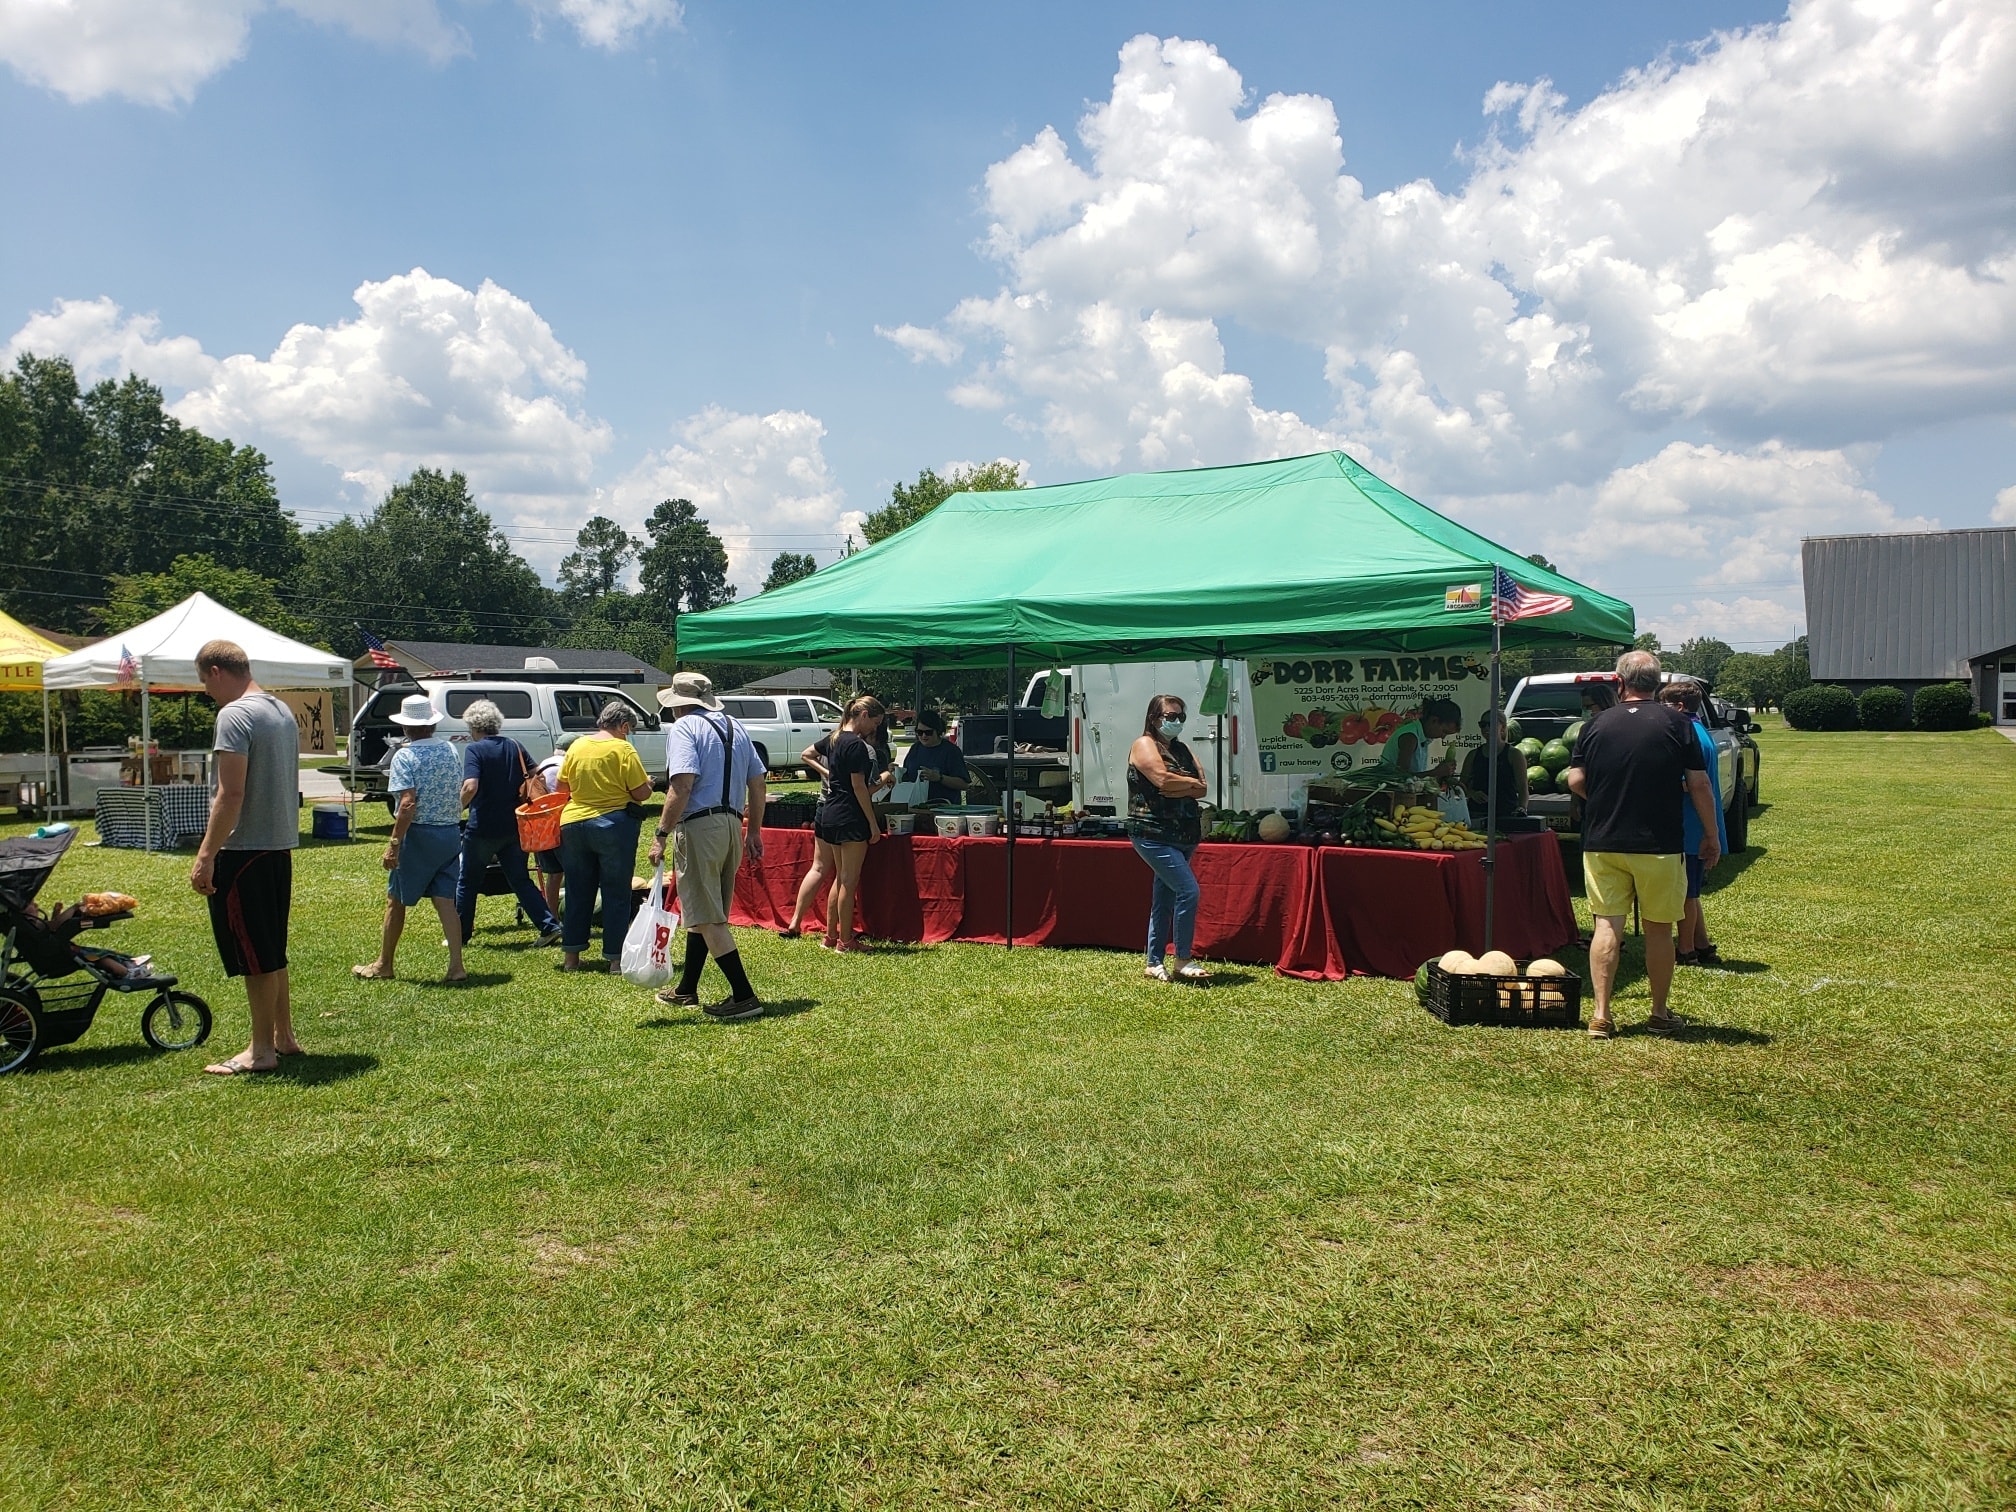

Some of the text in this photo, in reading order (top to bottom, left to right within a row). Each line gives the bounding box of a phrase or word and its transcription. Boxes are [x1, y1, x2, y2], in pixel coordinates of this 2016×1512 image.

[1273, 655, 1469, 685] DORR FARMS
[1294, 684, 1458, 695] 5225 Dorr Acres Road Gable, SC 29051
[1301, 694, 1360, 703] 803-495-2639
[1261, 735, 1287, 744] u-pick
[1455, 734, 1482, 742] u-pick
[1279, 759, 1296, 767] raw
[1297, 758, 1322, 767] honey
